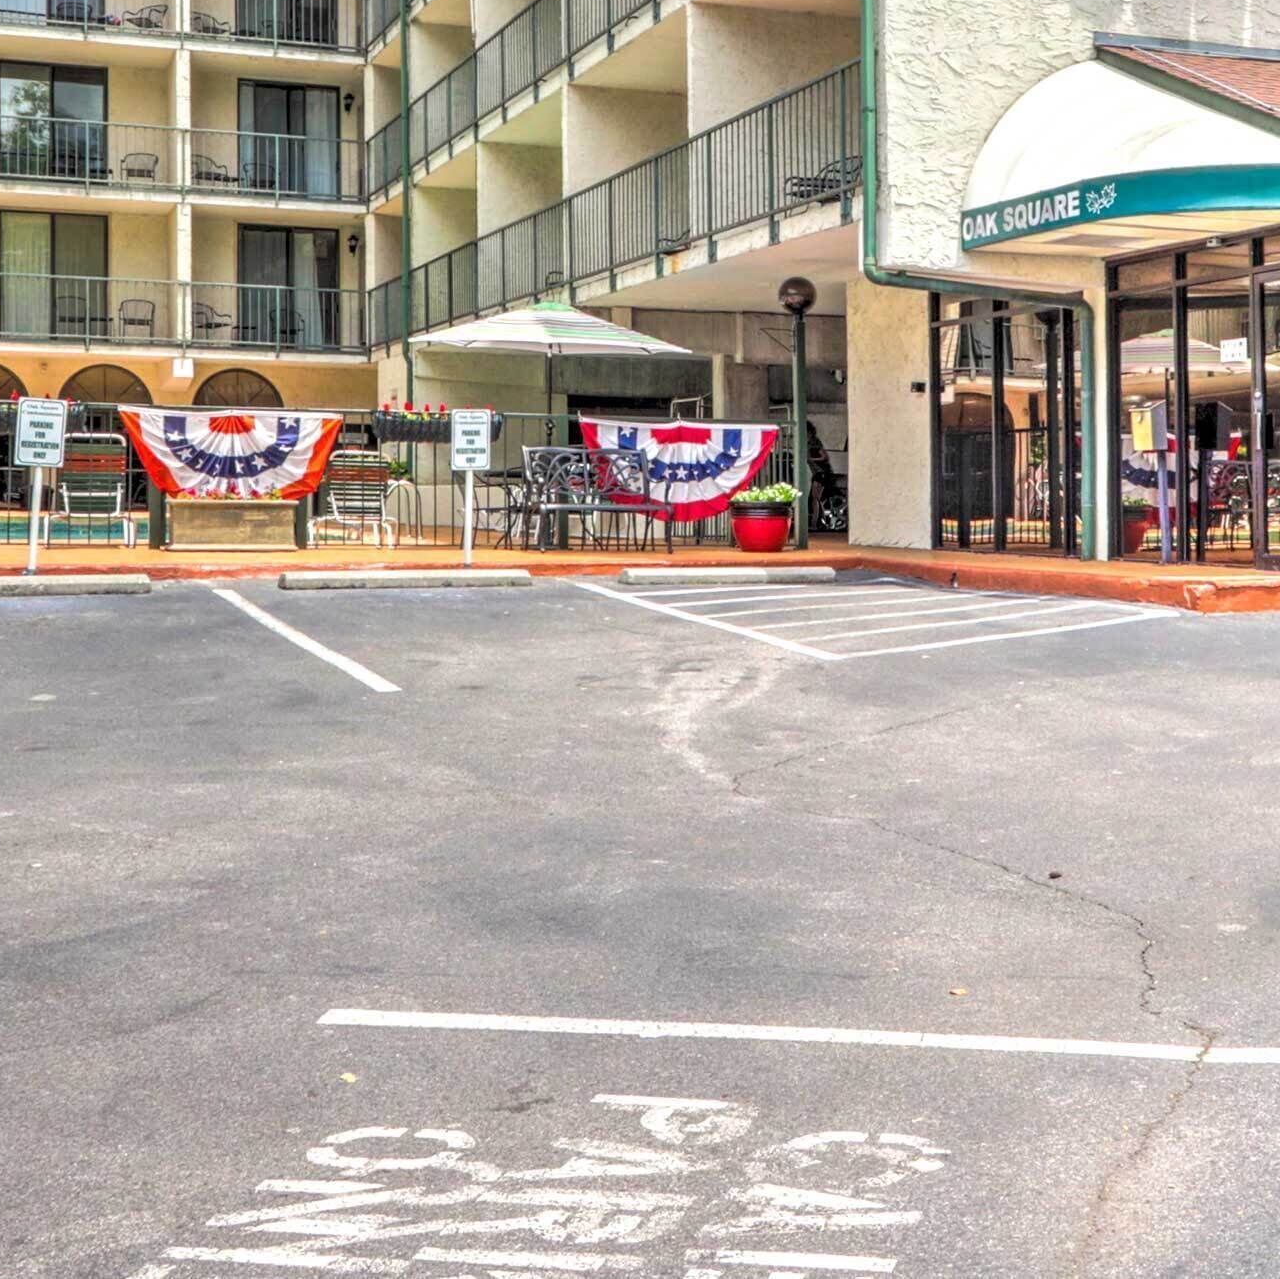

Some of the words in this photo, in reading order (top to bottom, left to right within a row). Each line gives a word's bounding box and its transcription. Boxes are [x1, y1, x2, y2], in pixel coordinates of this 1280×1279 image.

[962, 211, 999, 241] OAK
[1002, 189, 1081, 233] SQUARE
[30, 421, 54, 429] PARKING
[21, 441, 59, 449] REGISTRATION
